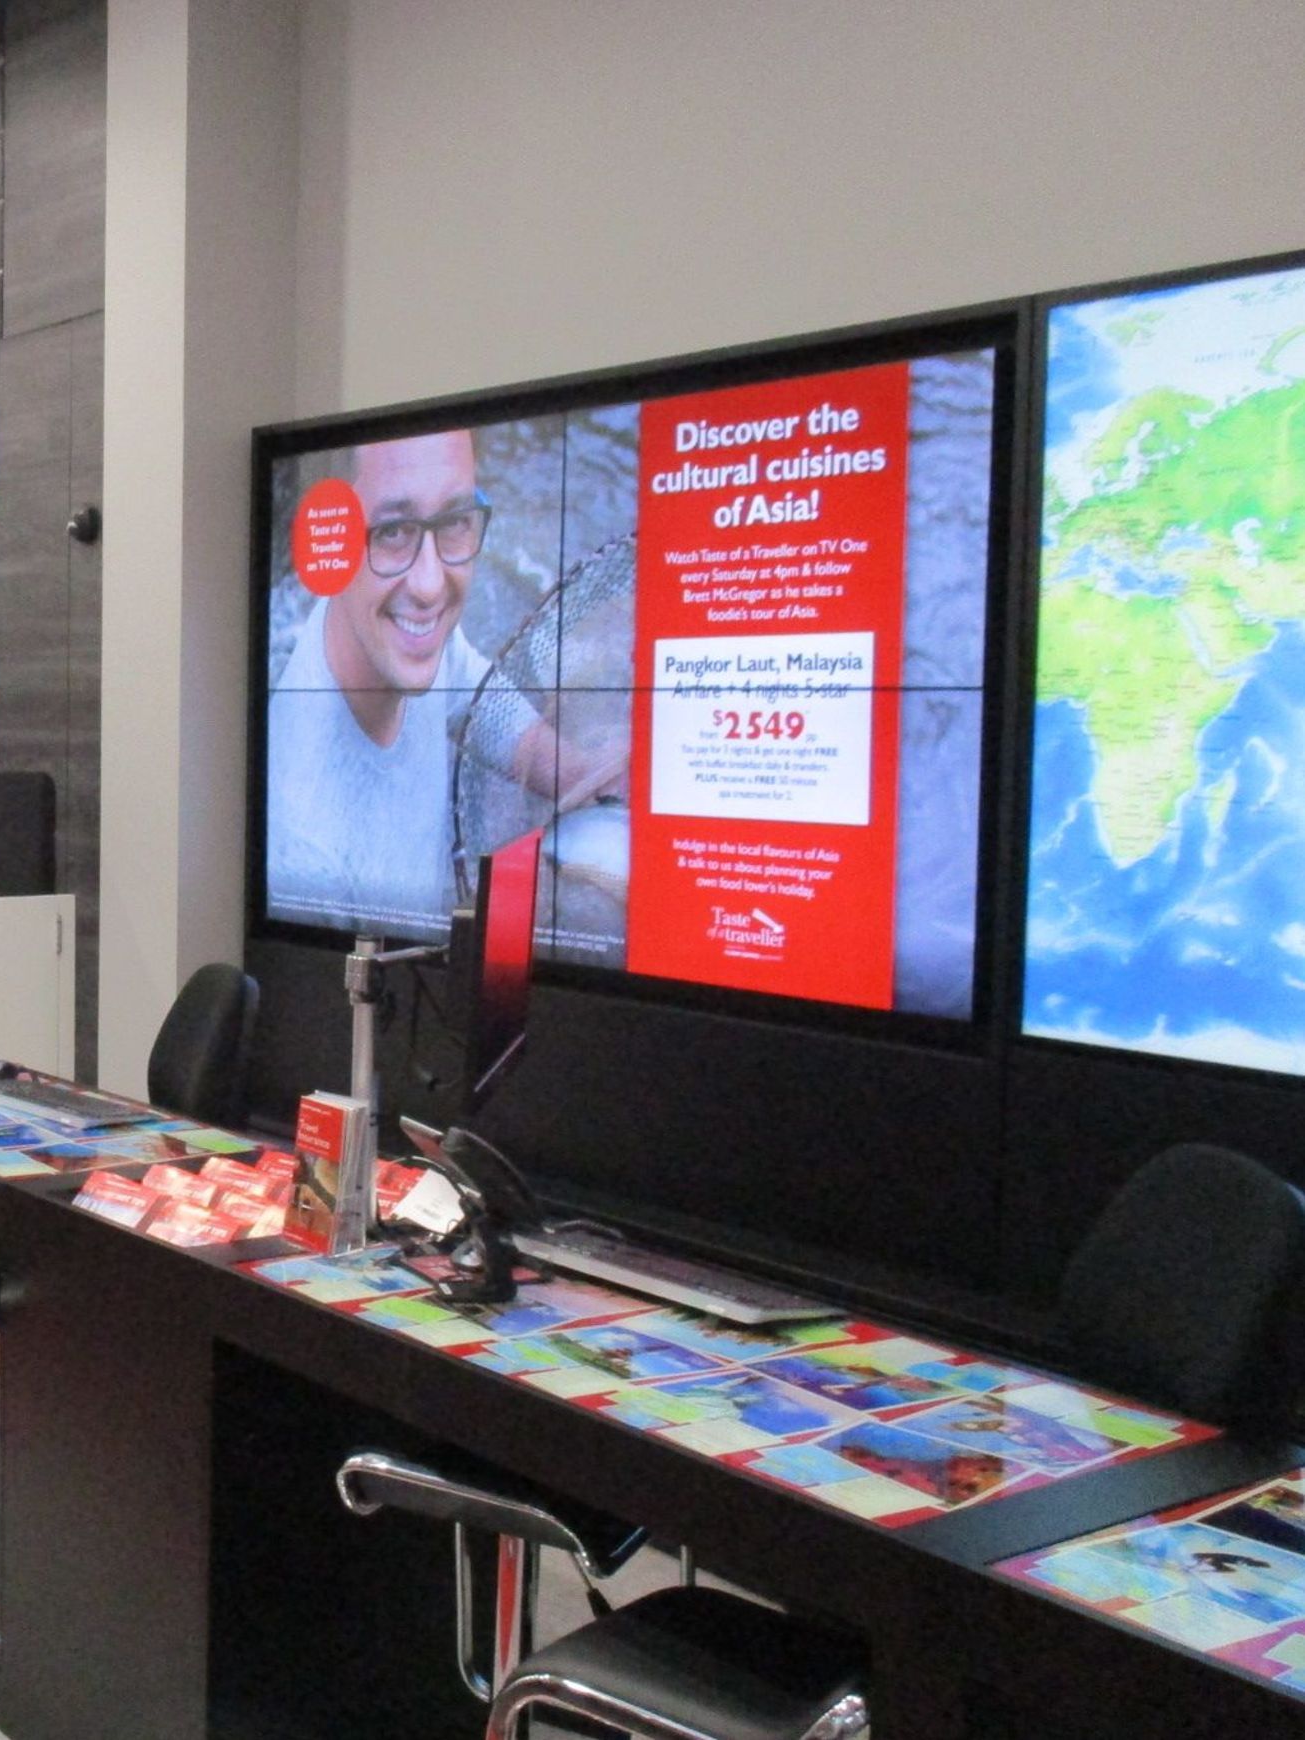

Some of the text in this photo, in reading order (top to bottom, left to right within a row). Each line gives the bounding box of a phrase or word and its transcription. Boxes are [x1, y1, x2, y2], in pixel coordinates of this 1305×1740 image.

[675, 402, 860, 452] Discover the
[651, 445, 887, 494] cultural cuisines
[713, 489, 820, 528] of Asia!
[664, 551, 698, 566] Watch
[700, 547, 727, 562] Taste
[730, 546, 743, 561] of
[751, 544, 800, 559] Traveller
[802, 545, 817, 556] on
[819, 539, 838, 555] TV
[840, 538, 868, 553] One
[318, 559, 331, 570] TV
[332, 558, 350, 570] One
[679, 561, 852, 586] every Saturday at 4pm & follow
[682, 583, 844, 604] Brett McGregor as he takes a
[706, 606, 748, 622] foodie's
[750, 607, 776, 620] tour
[778, 604, 791, 619] of
[664, 652, 863, 678] Pangkor Laut, Malaysia
[672, 680, 722, 700] Airfare
[754, 679, 799, 704] nights
[814, 746, 838, 757] FREE
[695, 773, 718, 783] PLUS
[754, 775, 776, 785] FREE
[738, 843, 762, 857] local
[719, 877, 743, 890] food
[710, 905, 751, 928] Taste
[725, 927, 786, 947] traveller
